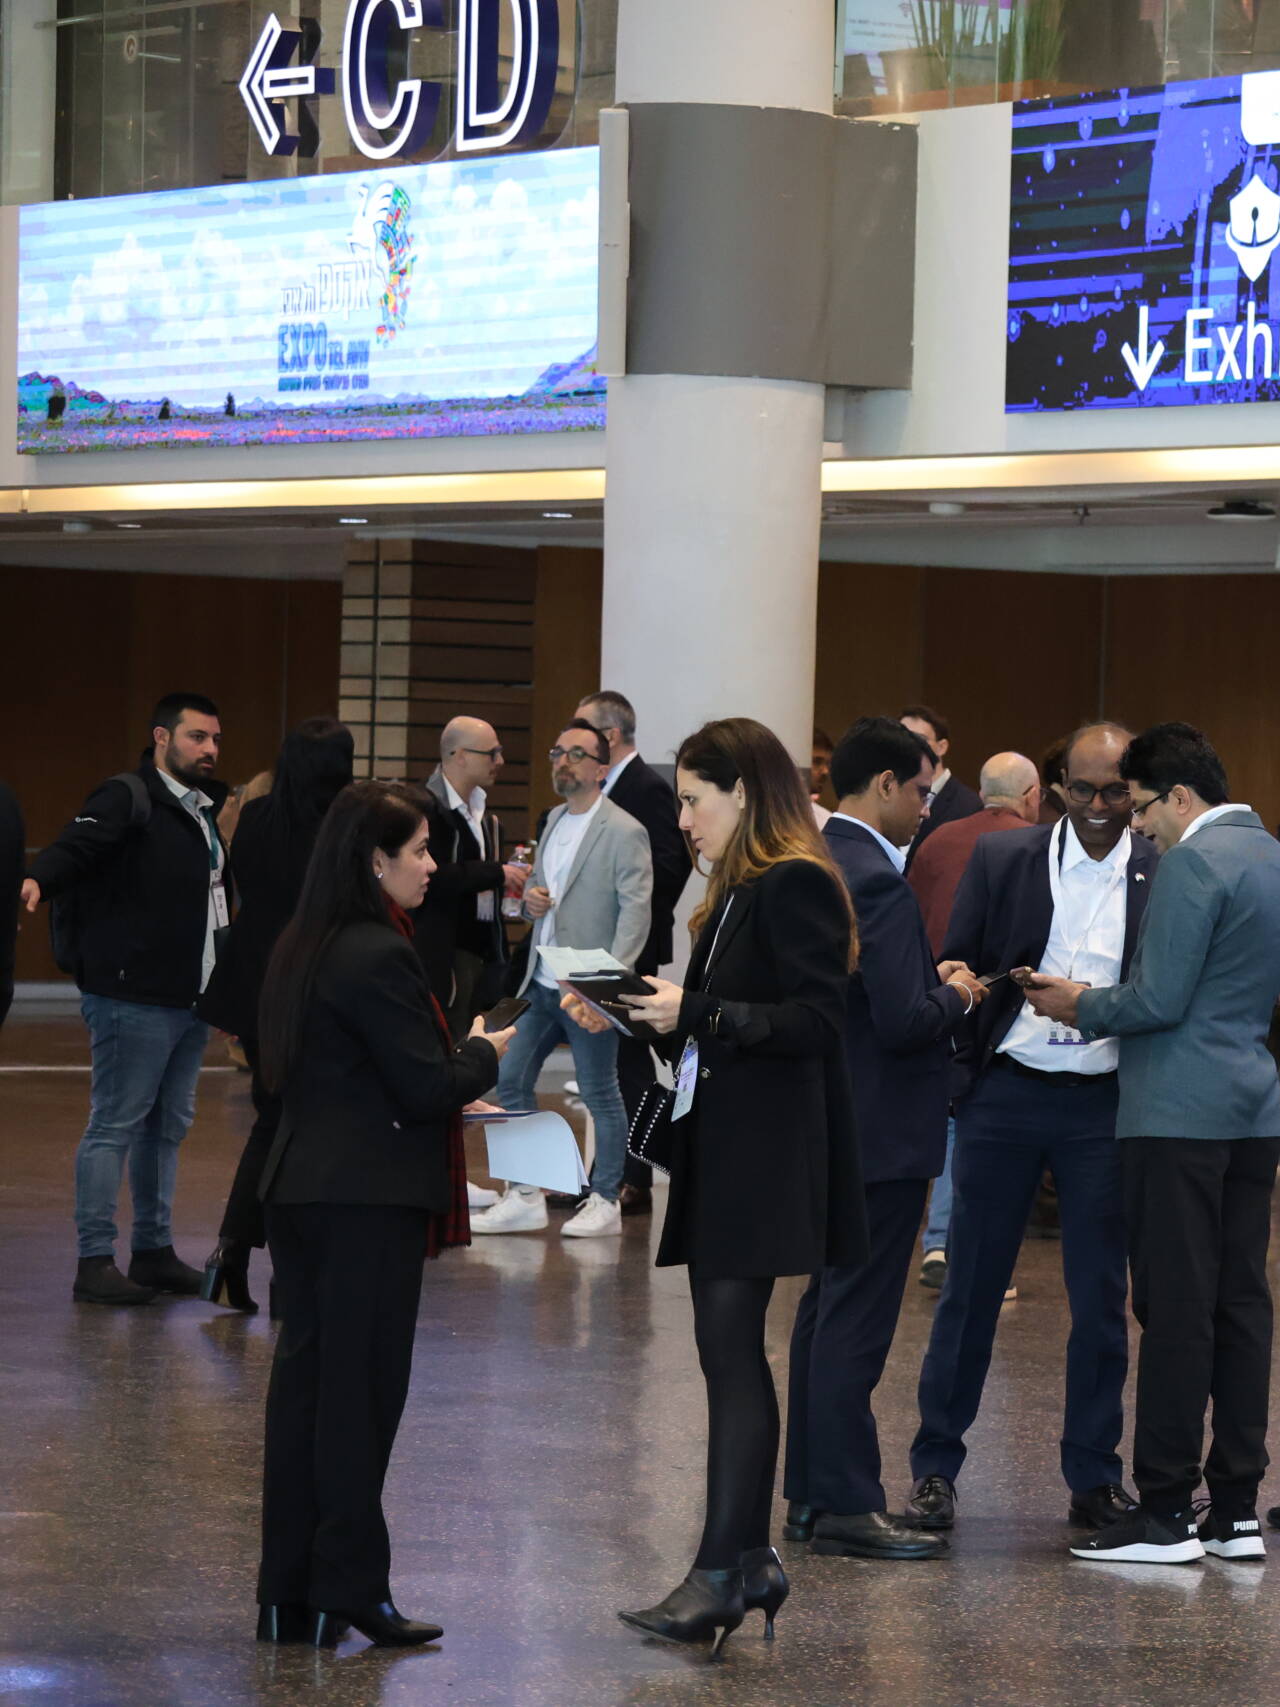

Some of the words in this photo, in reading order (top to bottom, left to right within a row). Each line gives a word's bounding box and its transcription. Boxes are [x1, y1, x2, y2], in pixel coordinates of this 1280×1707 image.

[343, 0, 426, 160] C
[457, 0, 543, 151] D
[278, 322, 328, 373] EXPO
